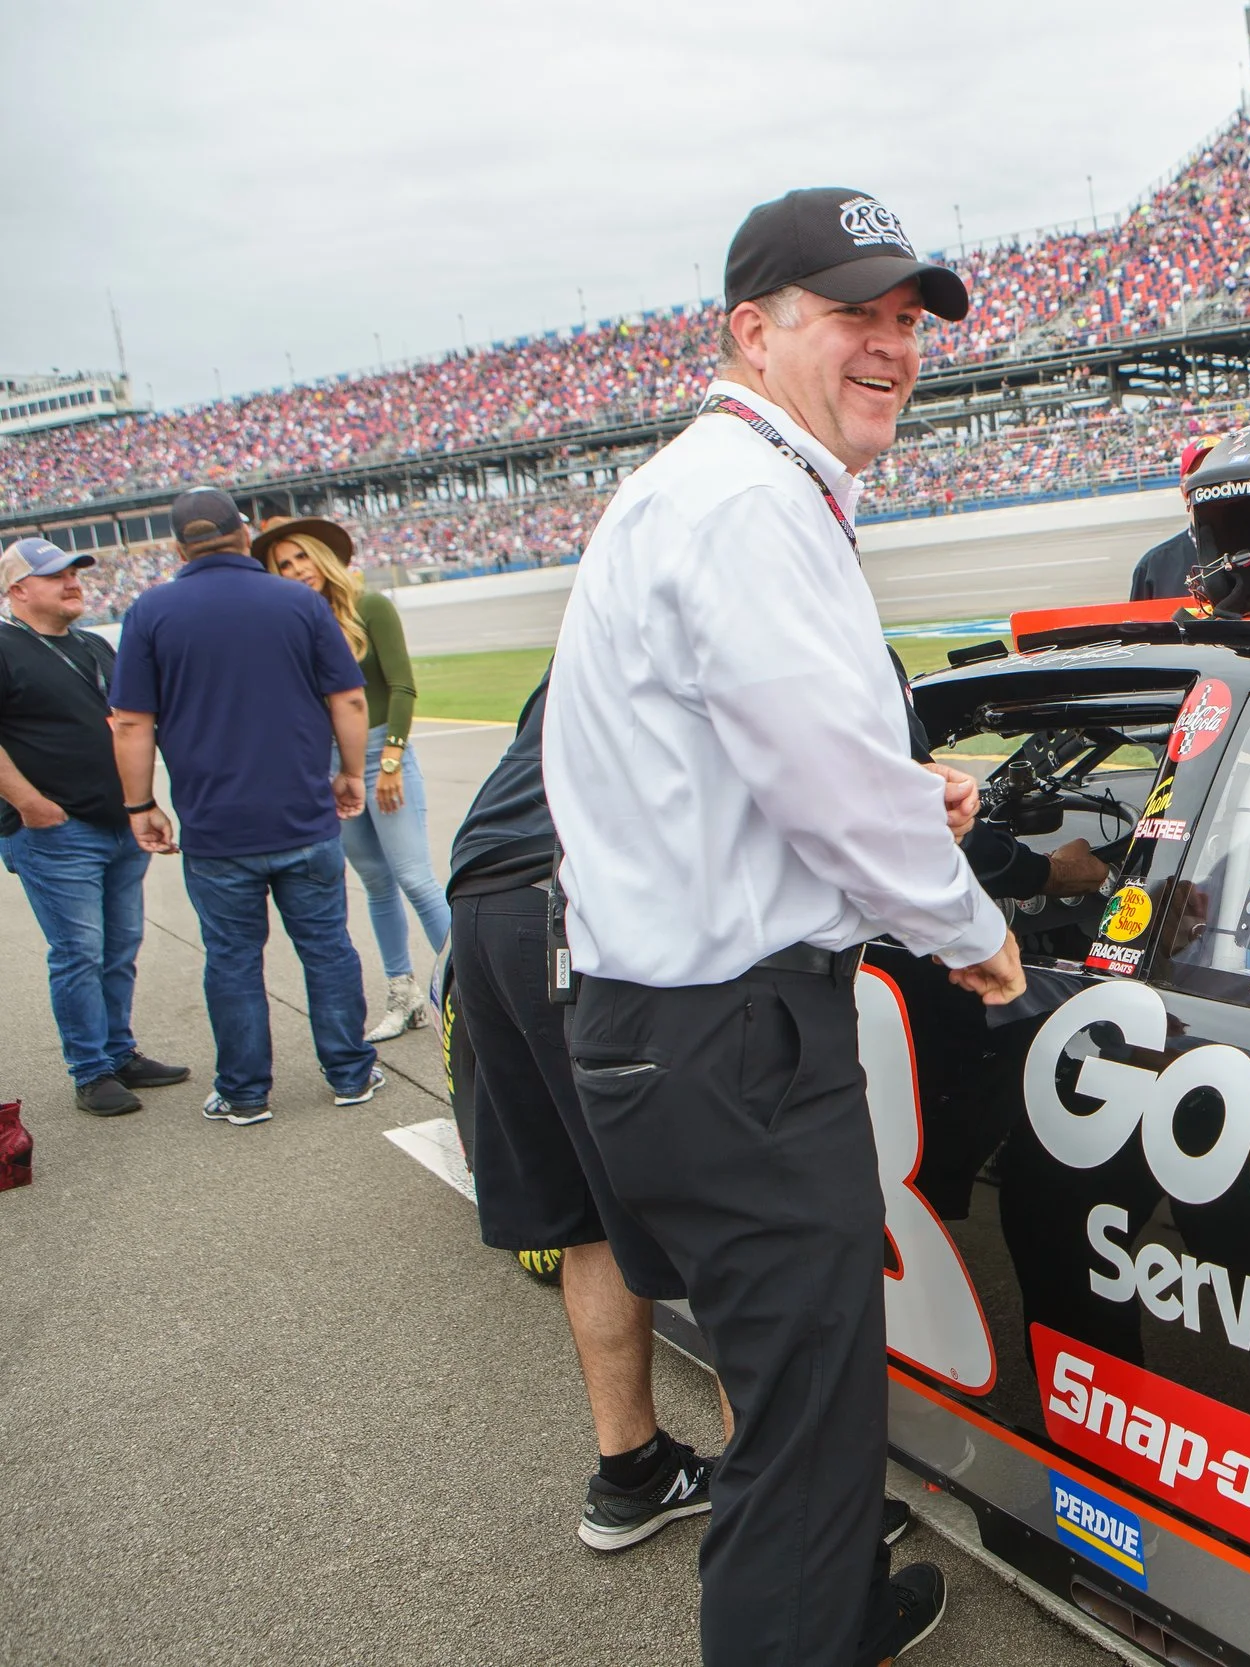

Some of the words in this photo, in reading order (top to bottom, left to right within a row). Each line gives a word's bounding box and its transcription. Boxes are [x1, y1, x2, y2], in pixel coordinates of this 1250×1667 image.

[1134, 818, 1187, 841] EALTREE
[1123, 888, 1145, 905] Bass
[1120, 904, 1137, 918] Pro
[1115, 915, 1143, 935] Shops
[1090, 942, 1141, 965] TRACKER
[1108, 962, 1134, 975] BOATS
[1055, 1486, 1140, 1557] PERDUE
